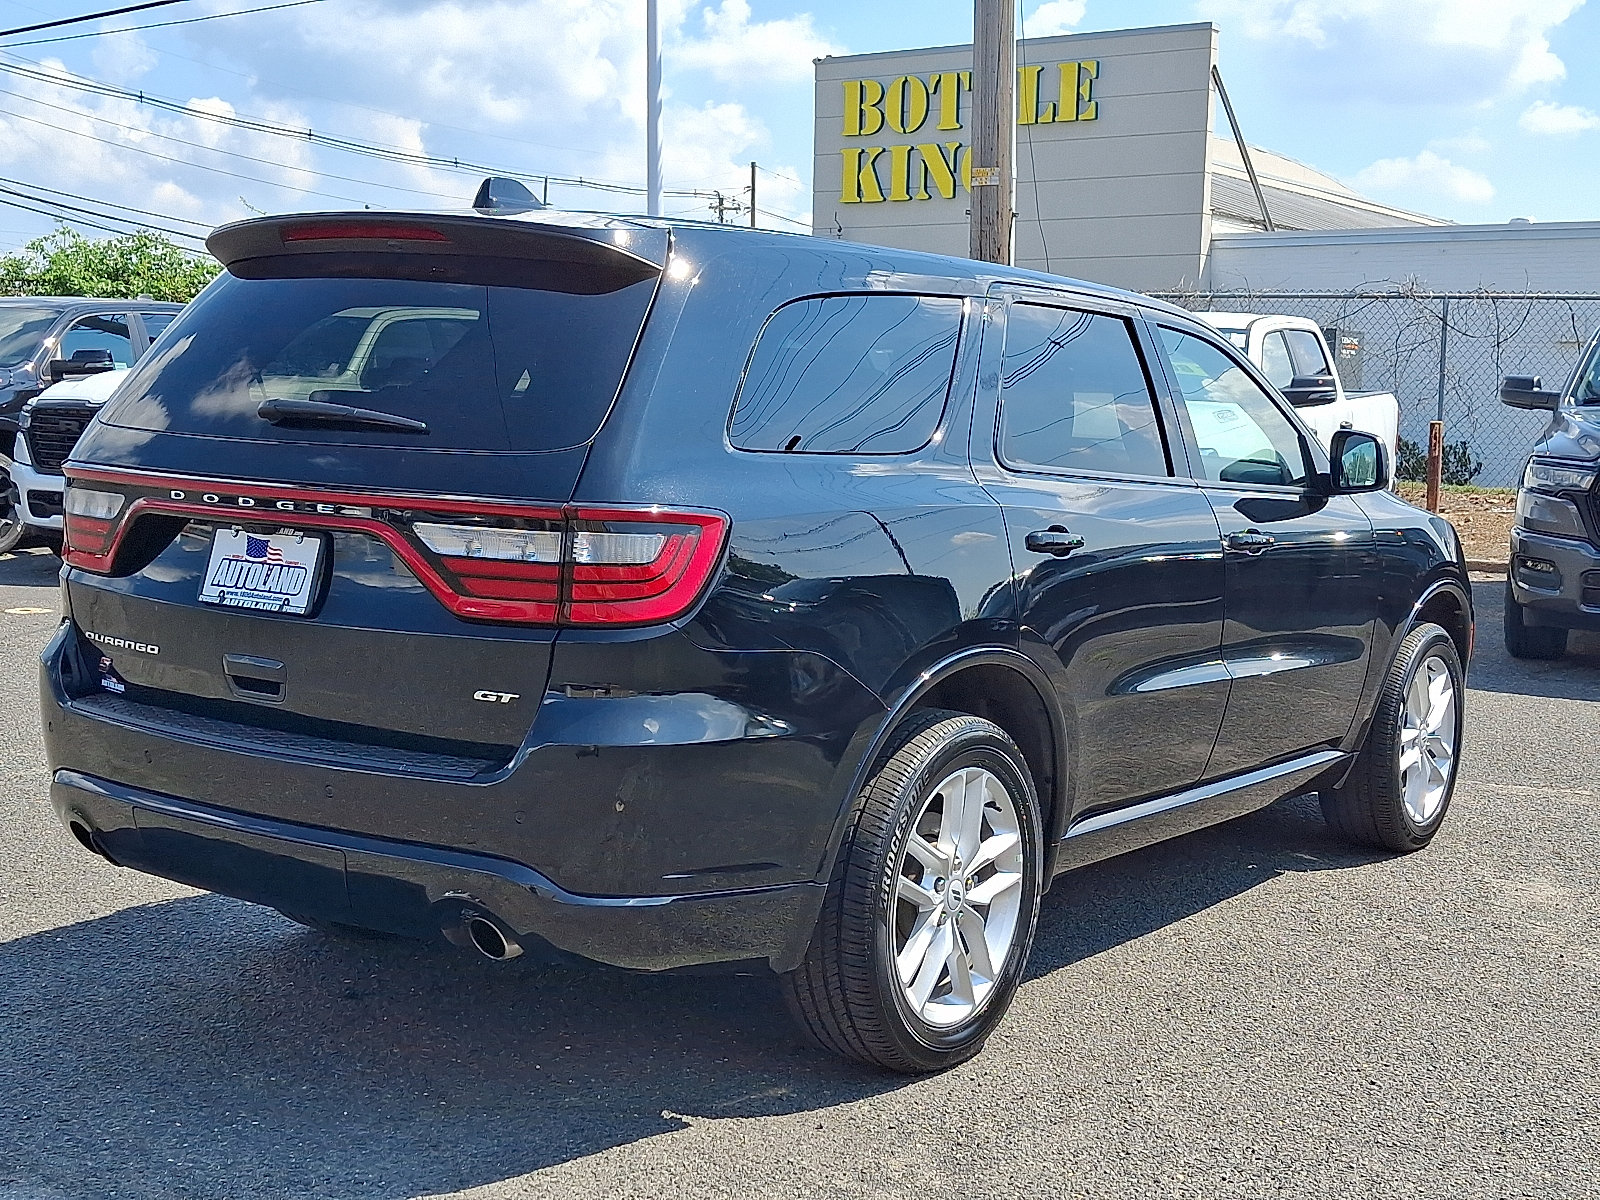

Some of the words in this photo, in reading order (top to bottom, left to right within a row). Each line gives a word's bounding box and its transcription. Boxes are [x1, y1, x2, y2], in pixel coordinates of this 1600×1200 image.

[842, 60, 1099, 137] BOTLE
[170, 490, 336, 514] DODGE
[211, 559, 307, 596] AUTOLAND
[222, 598, 281, 612] AUTOLAND
[85, 631, 160, 655] DURANGO
[473, 690, 520, 703] GT
